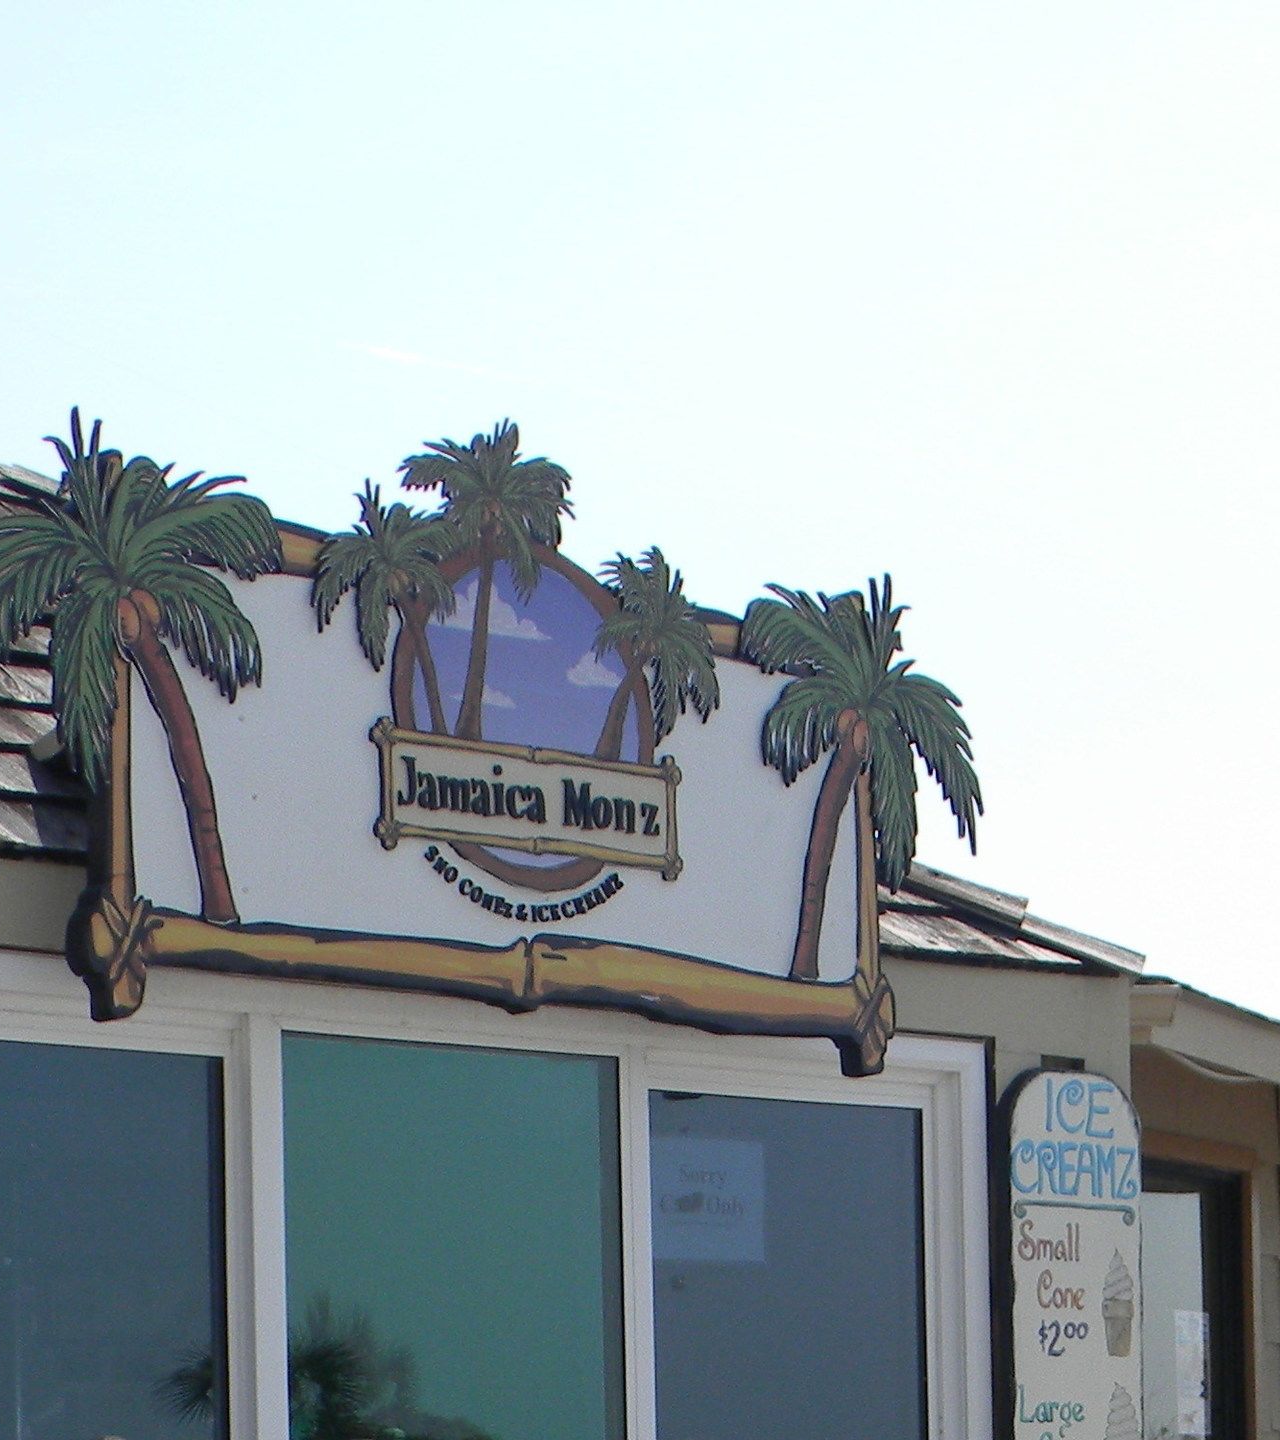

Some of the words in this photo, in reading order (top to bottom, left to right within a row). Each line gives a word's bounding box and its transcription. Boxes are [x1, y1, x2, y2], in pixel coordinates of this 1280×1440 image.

[397, 754, 547, 824] Jamaica
[560, 778, 661, 837] Monz
[424, 845, 459, 883] SNO
[515, 903, 528, 922] &
[1044, 1078, 1115, 1139] ICE
[1010, 1139, 1140, 1200] CREAMZ
[1017, 1219, 1081, 1263] Small
[1037, 1269, 1086, 1310] Cone
[1018, 1383, 1086, 1438] Large
